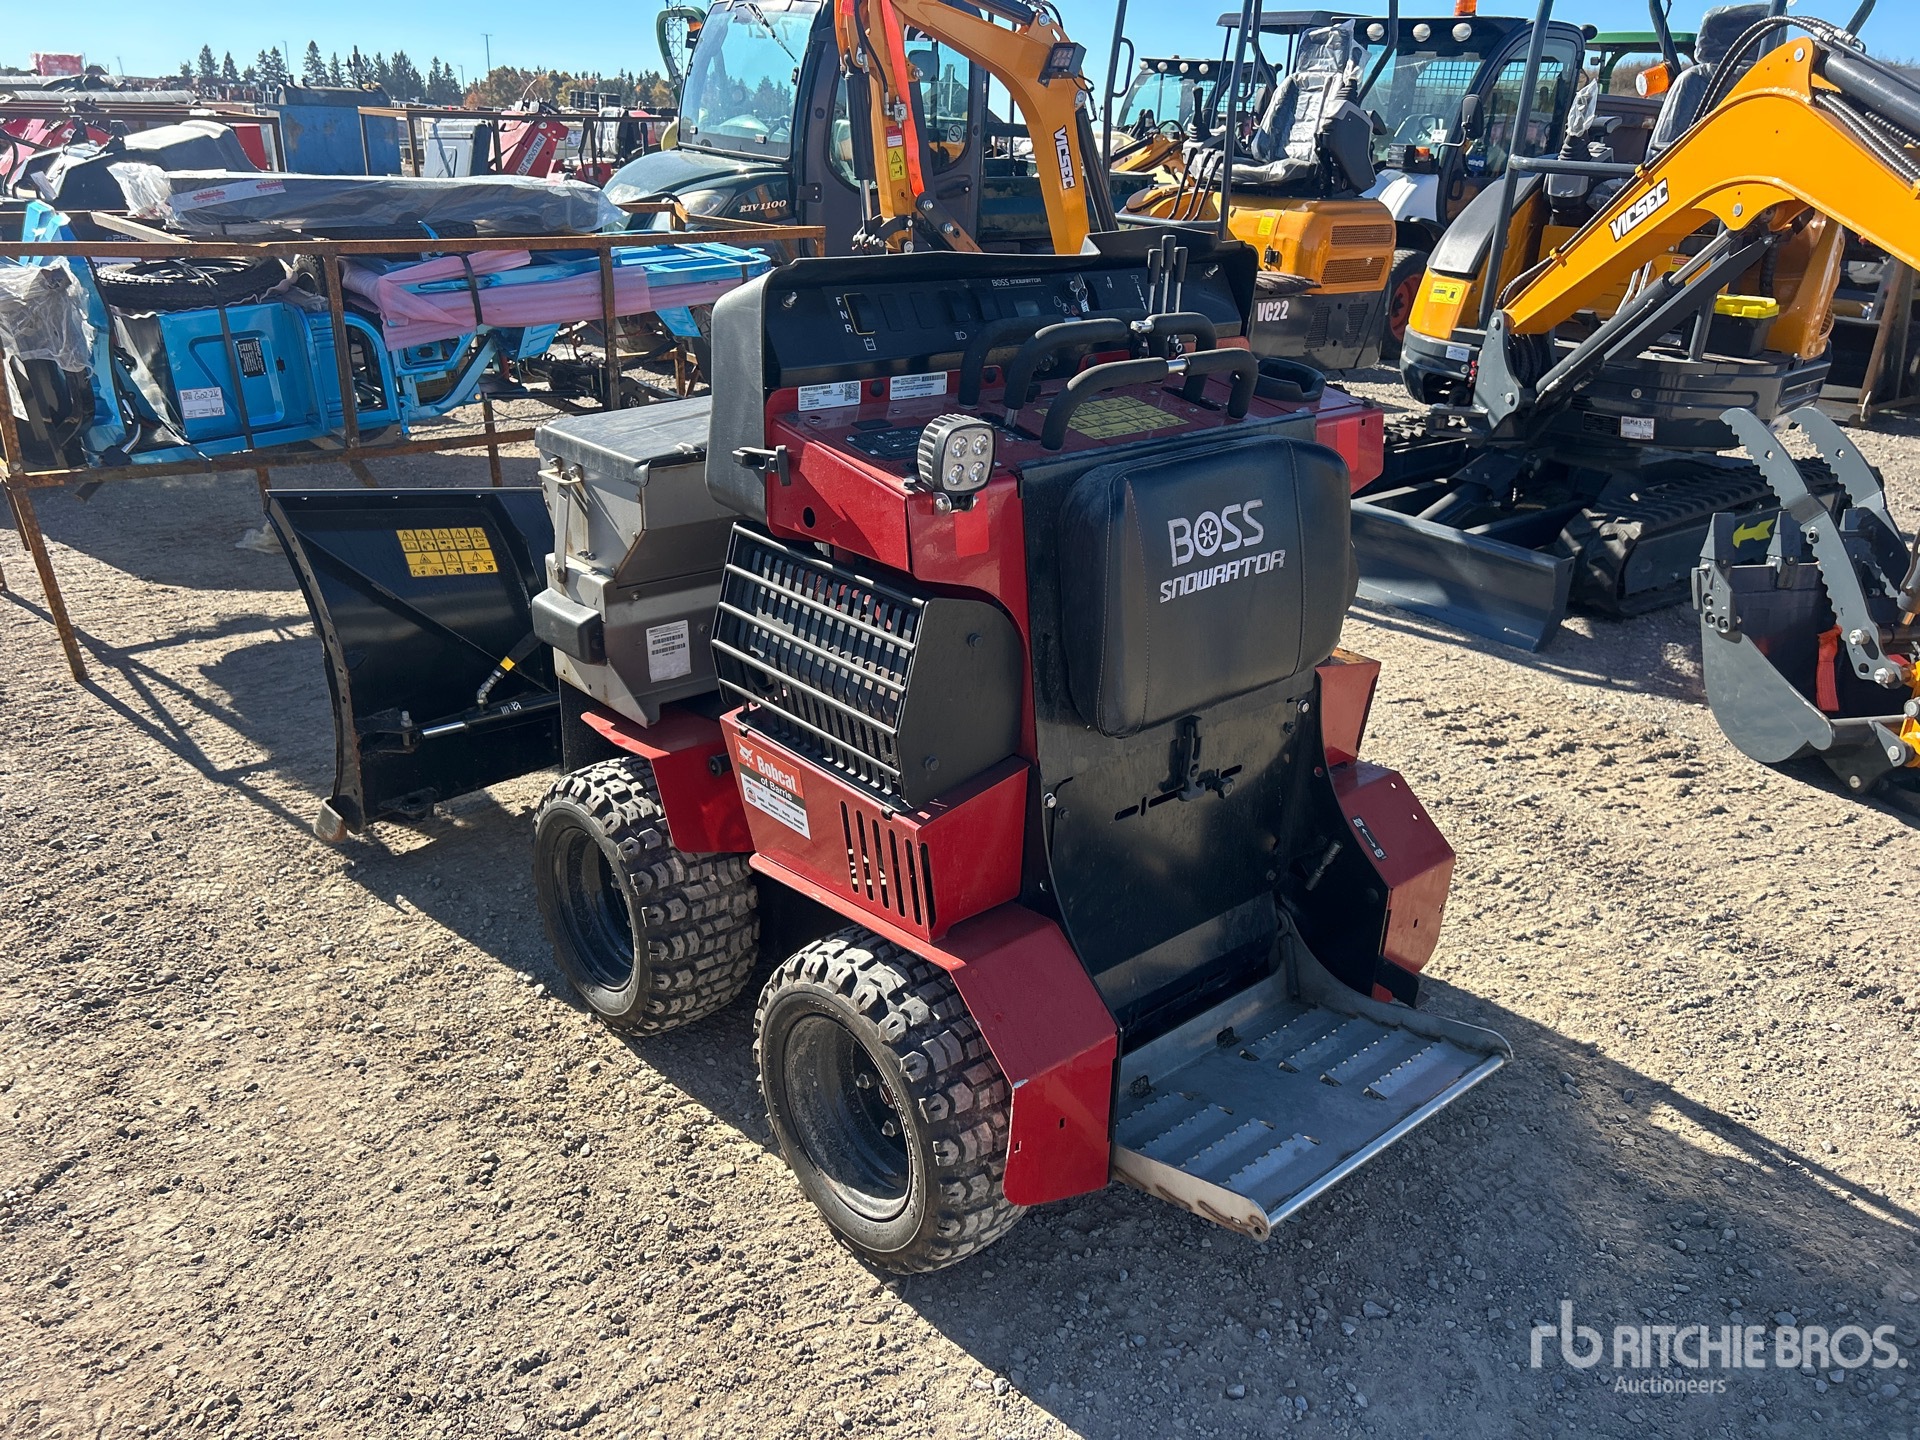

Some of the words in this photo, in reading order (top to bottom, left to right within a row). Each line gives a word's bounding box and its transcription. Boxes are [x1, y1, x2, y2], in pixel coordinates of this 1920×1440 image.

[1053, 124, 1075, 190] VICSEC
[739, 203, 760, 213] RTV
[760, 199, 787, 210] 1100
[1608, 177, 1670, 243] VICSEC
[991, 279, 1010, 287] BOSS
[835, 296, 842, 306] F
[1257, 300, 1289, 322] VC22
[840, 310, 849, 320] N
[844, 324, 853, 333] R
[1167, 499, 1264, 568] BOSS
[1160, 549, 1286, 603] SNOWRATOR
[756, 754, 797, 792] Bobcat
[760, 777, 769, 786] of
[769, 781, 793, 801] Barrie
